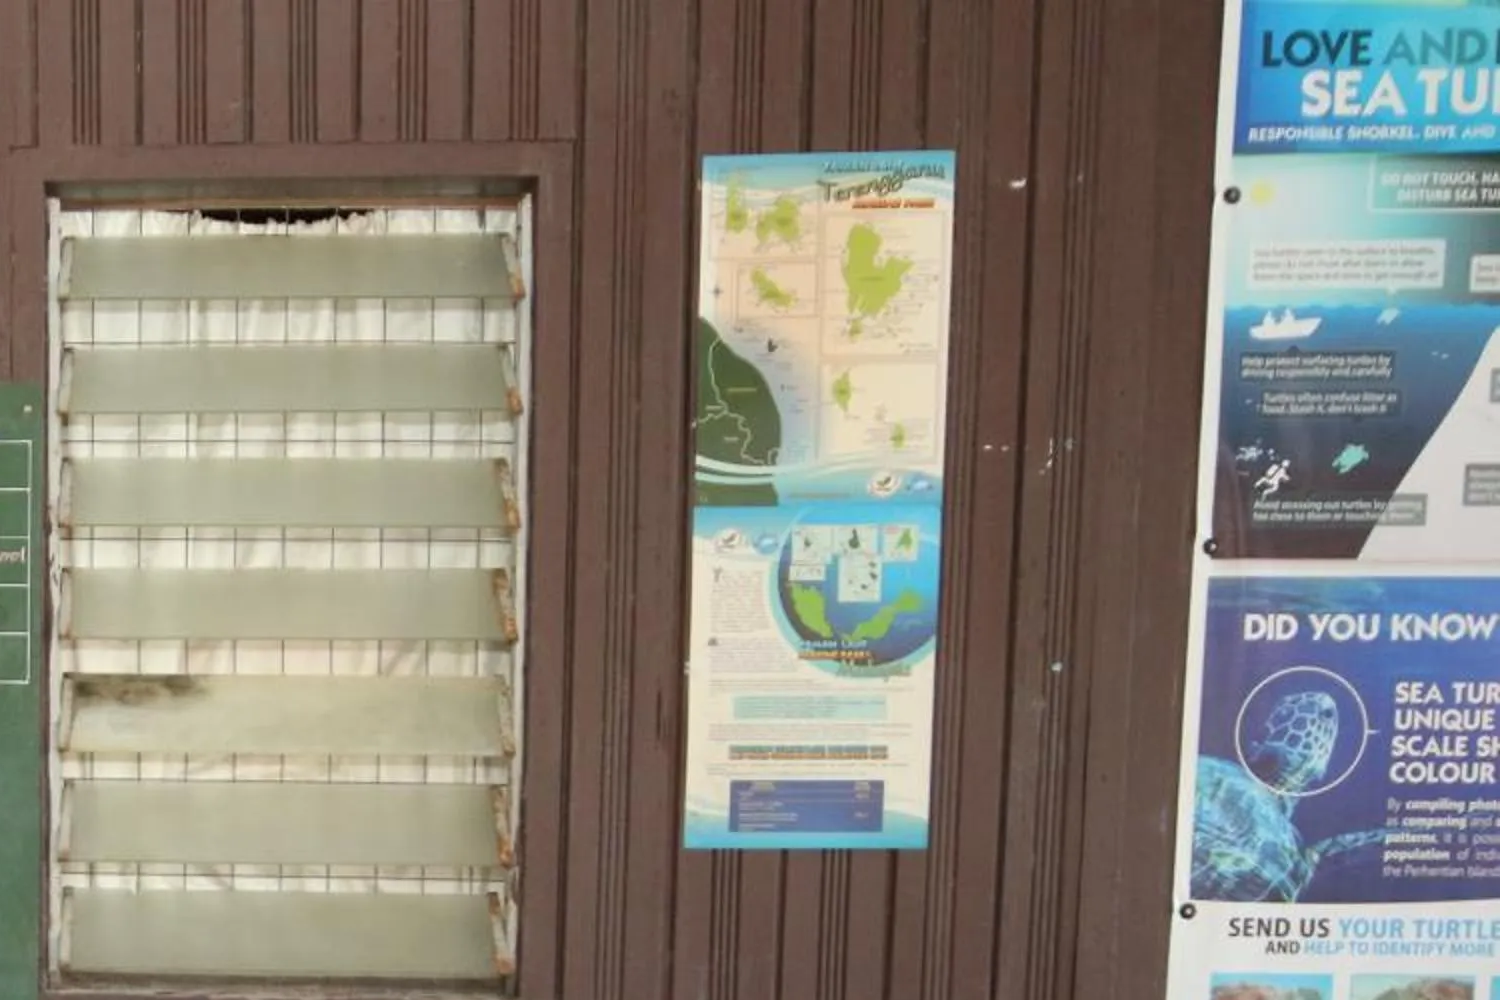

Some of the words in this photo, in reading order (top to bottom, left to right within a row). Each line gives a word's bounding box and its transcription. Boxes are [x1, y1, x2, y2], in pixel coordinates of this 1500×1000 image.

[1261, 30, 1372, 68] LOVE
[1383, 27, 1488, 67] AND
[1301, 68, 1408, 118] SEA
[1248, 126, 1343, 143] RESPONSIBLE
[1423, 124, 1457, 140] DIVE
[1243, 612, 1298, 641] DID
[1308, 612, 1381, 641] YOU
[1390, 611, 1499, 642] KNOW
[1394, 681, 1445, 704] SEA
[1451, 681, 1500, 705] TUR
[1394, 708, 1496, 732] UNIQUE
[1390, 735, 1469, 758] SCALE
[1388, 762, 1496, 785] COLOUR
[1383, 847, 1450, 863] population
[1228, 917, 1291, 938] SEND
[1300, 917, 1331, 938] US
[1338, 917, 1405, 940] YOUR
[1411, 917, 1500, 941] TURTLE
[1265, 940, 1300, 955] AND
[1304, 940, 1345, 956] HELP
[1350, 941, 1370, 956] TO
[1374, 941, 1445, 957] IDENTIFY
[1449, 942, 1496, 958] MORE
